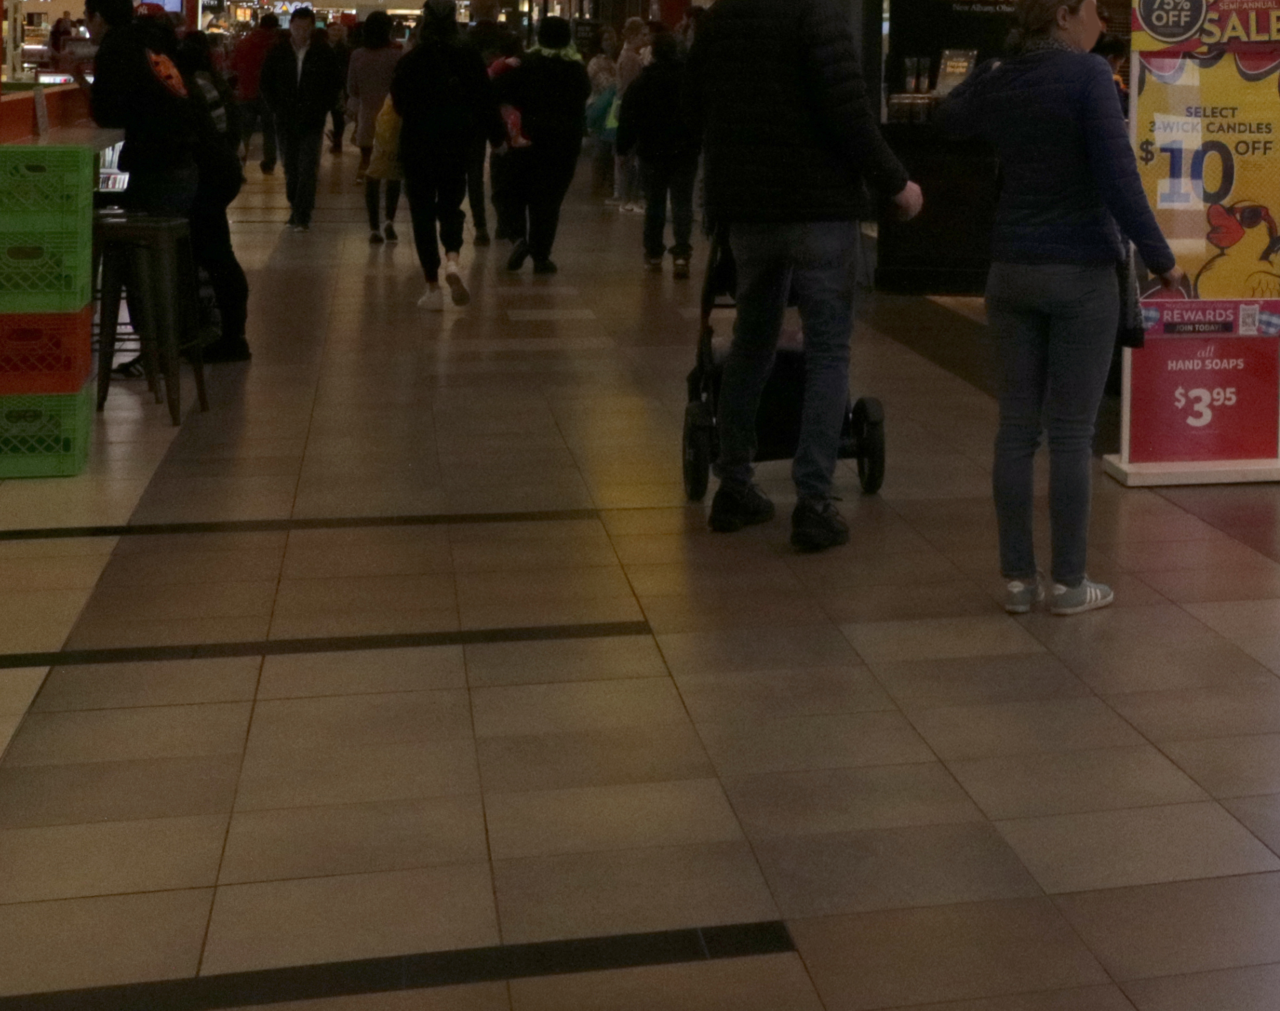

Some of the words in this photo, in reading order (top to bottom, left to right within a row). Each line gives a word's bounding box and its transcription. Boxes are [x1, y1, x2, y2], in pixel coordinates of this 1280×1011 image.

[1218, 1, 1278, 10] SEMI-ANNUAL
[1151, 10, 1191, 27] OFF
[1185, 106, 1239, 119] SELECT
[1148, 121, 1200, 135] 3-WICK
[1205, 122, 1273, 135] CANDLES
[1138, 138, 1235, 205] $10
[1234, 140, 1274, 156] OFF
[1162, 308, 1235, 323] REWARDS
[1175, 324, 1194, 332] JOIN
[1197, 345, 1215, 358] all
[1167, 359, 1202, 371] HAND
[1204, 358, 1245, 370] SOAPS
